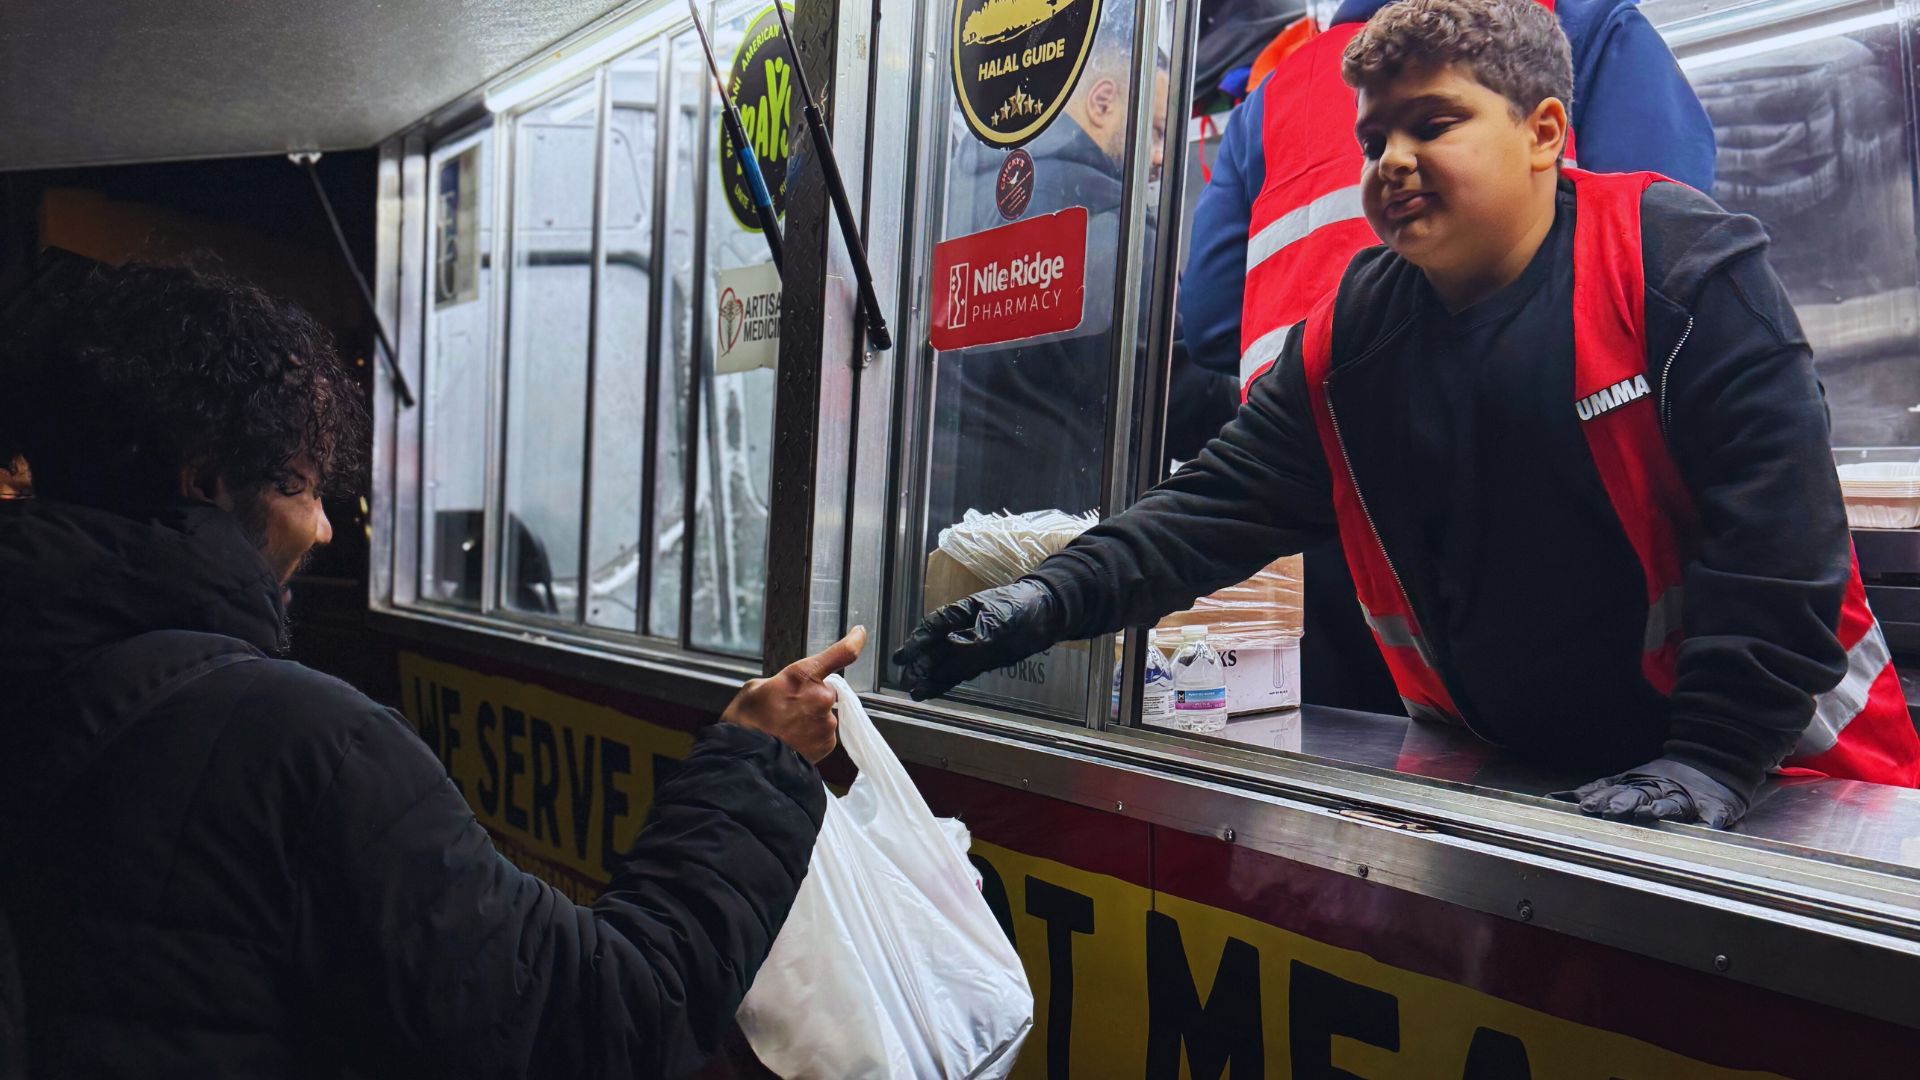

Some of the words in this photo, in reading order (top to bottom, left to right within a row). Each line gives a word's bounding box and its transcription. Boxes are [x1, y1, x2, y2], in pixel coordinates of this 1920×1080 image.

[742, 24, 780, 72] AMERICAN
[978, 53, 1020, 81] HALAL
[1022, 38, 1066, 68] GUIDE
[973, 261, 1009, 296] Nile
[1010, 251, 1065, 289] Ridge
[972, 289, 1062, 322] PHARMACY
[1575, 374, 1652, 421] UMMA
[477, 701, 632, 876] SERVE
